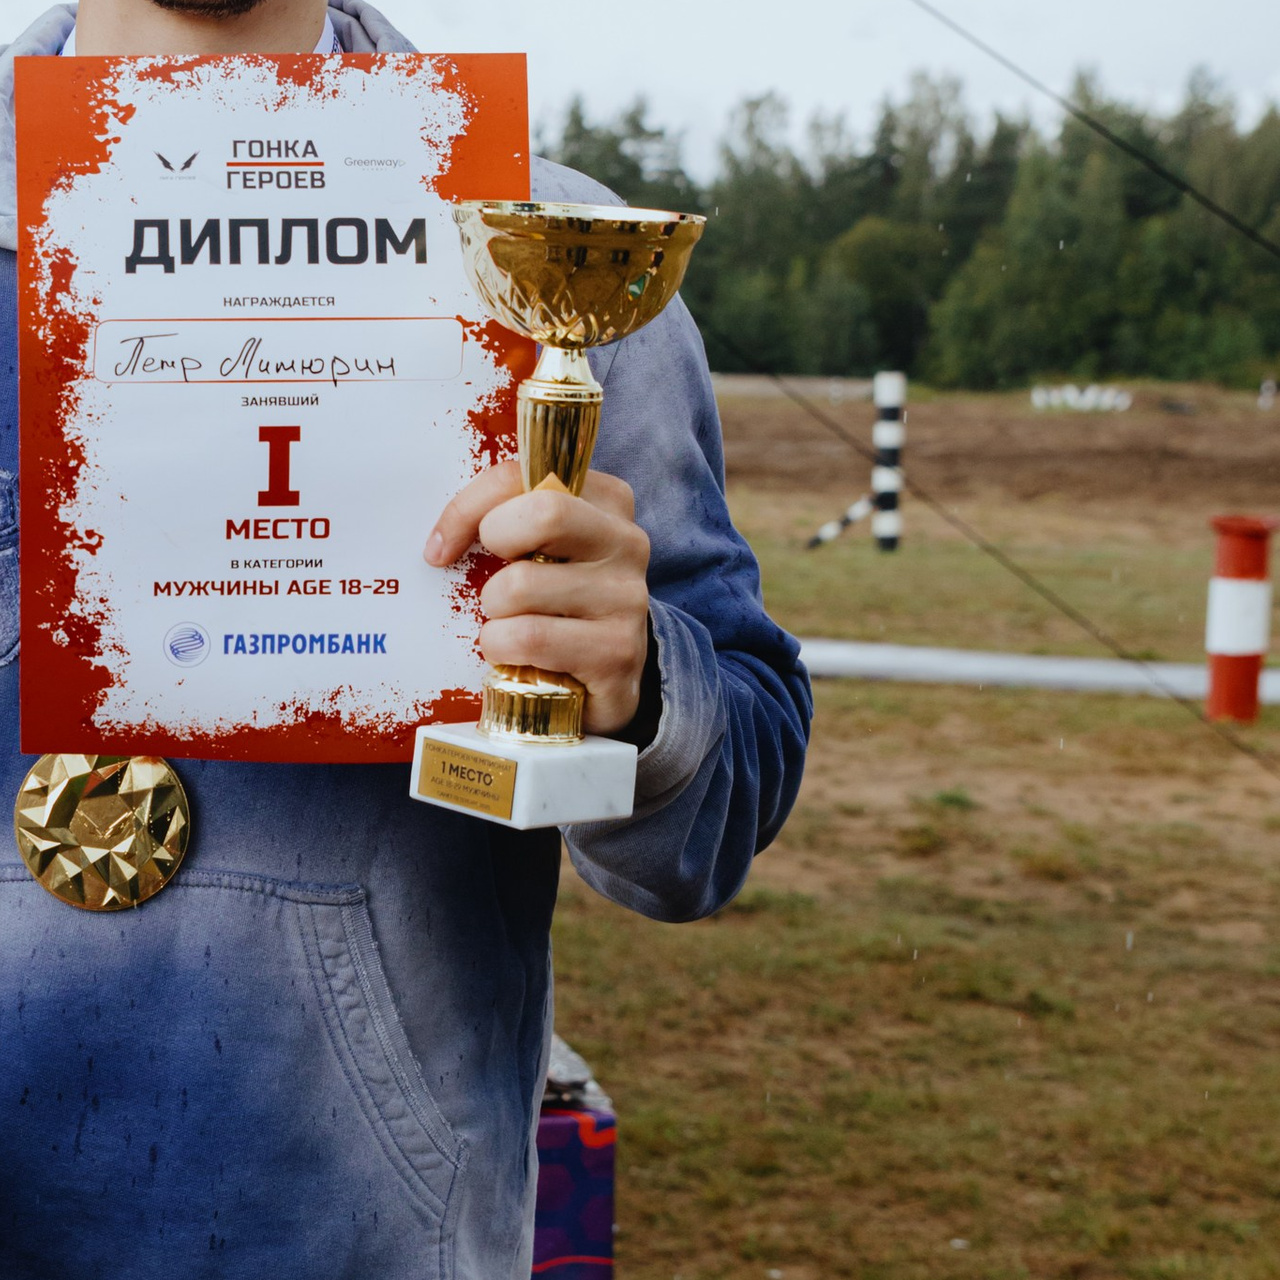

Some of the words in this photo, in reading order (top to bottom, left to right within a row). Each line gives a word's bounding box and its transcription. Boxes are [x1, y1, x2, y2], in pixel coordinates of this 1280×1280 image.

[232, 139, 319, 158] ГОНКА
[343, 156, 399, 169] Greenway
[226, 170, 326, 189] ГЕРОЕВ
[124, 217, 428, 274] ДИПЛОМ
[223, 296, 336, 308] НАГРАЖДАЕТСЯ
[241, 394, 320, 407] ЗАНЯВШИЙ
[257, 425, 301, 507] I
[225, 517, 331, 540] МЕСТО
[230, 559, 240, 569] В
[243, 558, 323, 569] КАТЕГОРИИ
[153, 580, 280, 597] МУЖЧИНЫ
[287, 579, 332, 595] AGE
[339, 578, 401, 595] 18-29
[223, 633, 388, 655] ГАЗПРОМБАНК
[441, 761, 447, 774] 1
[449, 763, 493, 786] МЕСТО
